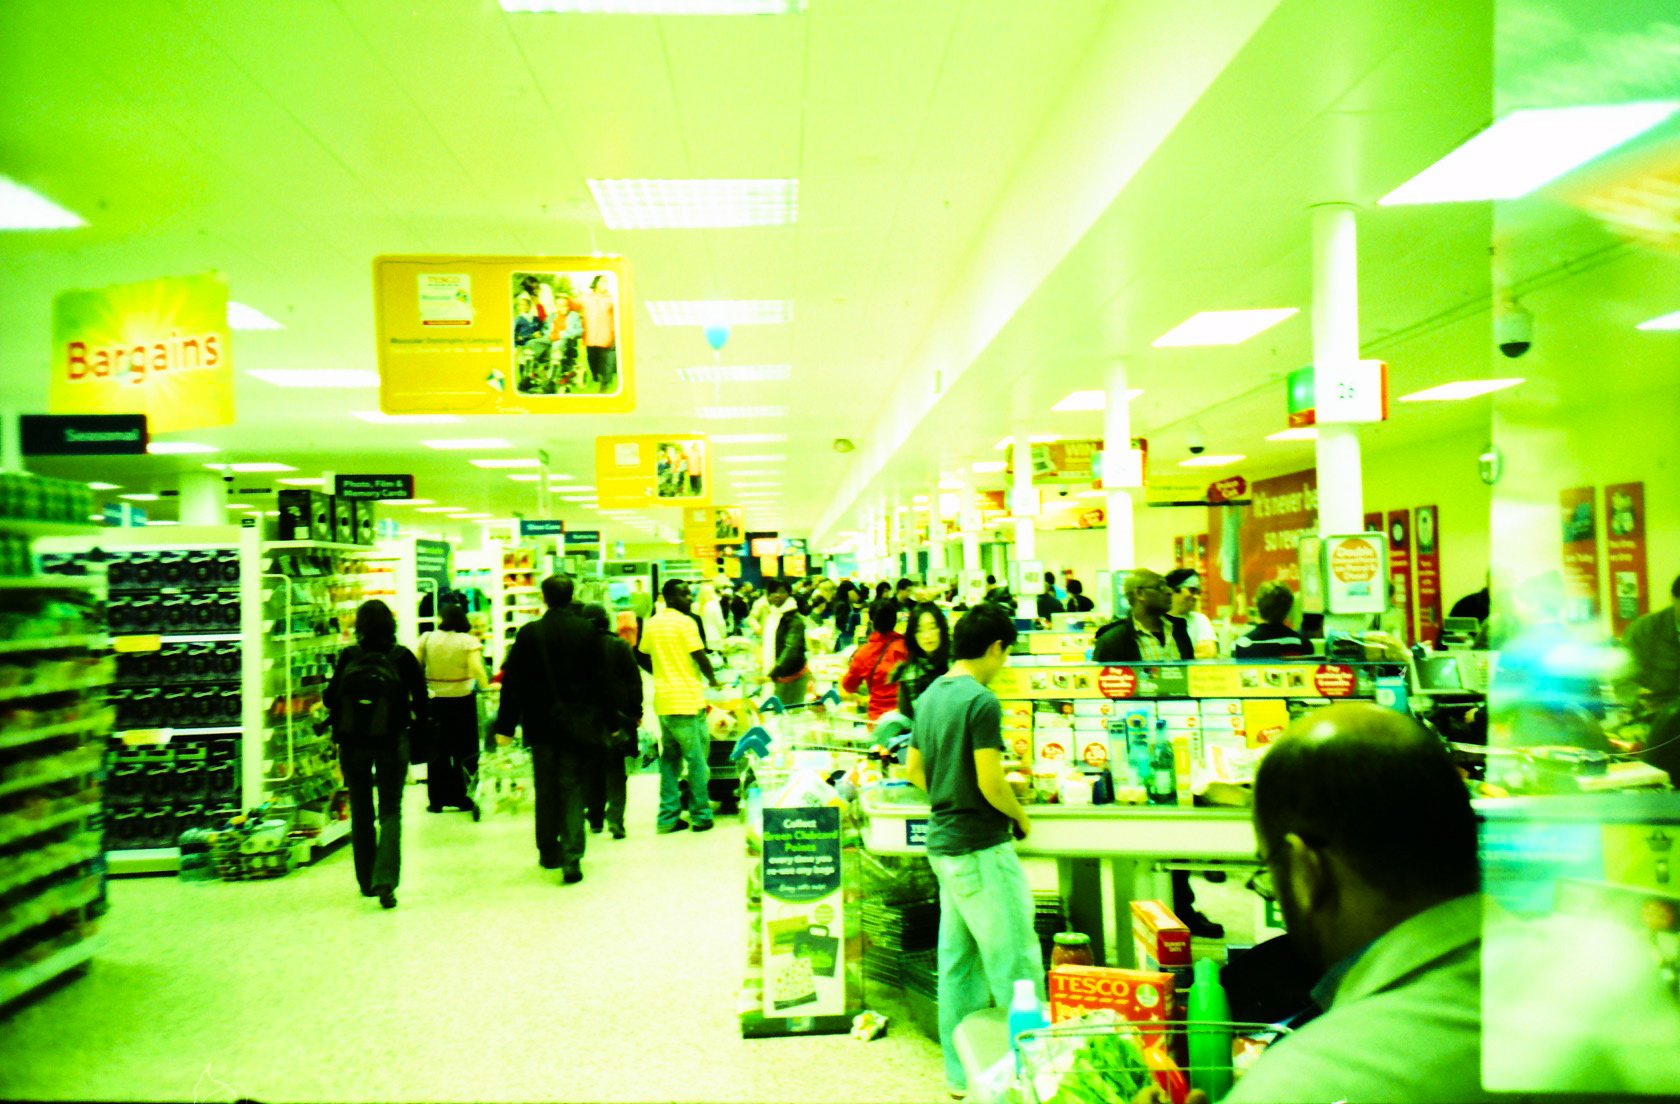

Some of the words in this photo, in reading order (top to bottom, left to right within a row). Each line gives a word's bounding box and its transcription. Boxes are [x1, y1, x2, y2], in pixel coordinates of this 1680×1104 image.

[67, 333, 219, 384] Bargains
[343, 490, 381, 498] Memory
[382, 489, 407, 497] Cards
[783, 818, 817, 828] Collect
[763, 831, 793, 841] Green
[794, 830, 838, 840] Clubcard
[784, 843, 817, 852] Points
[1053, 975, 1130, 997] TESCO
